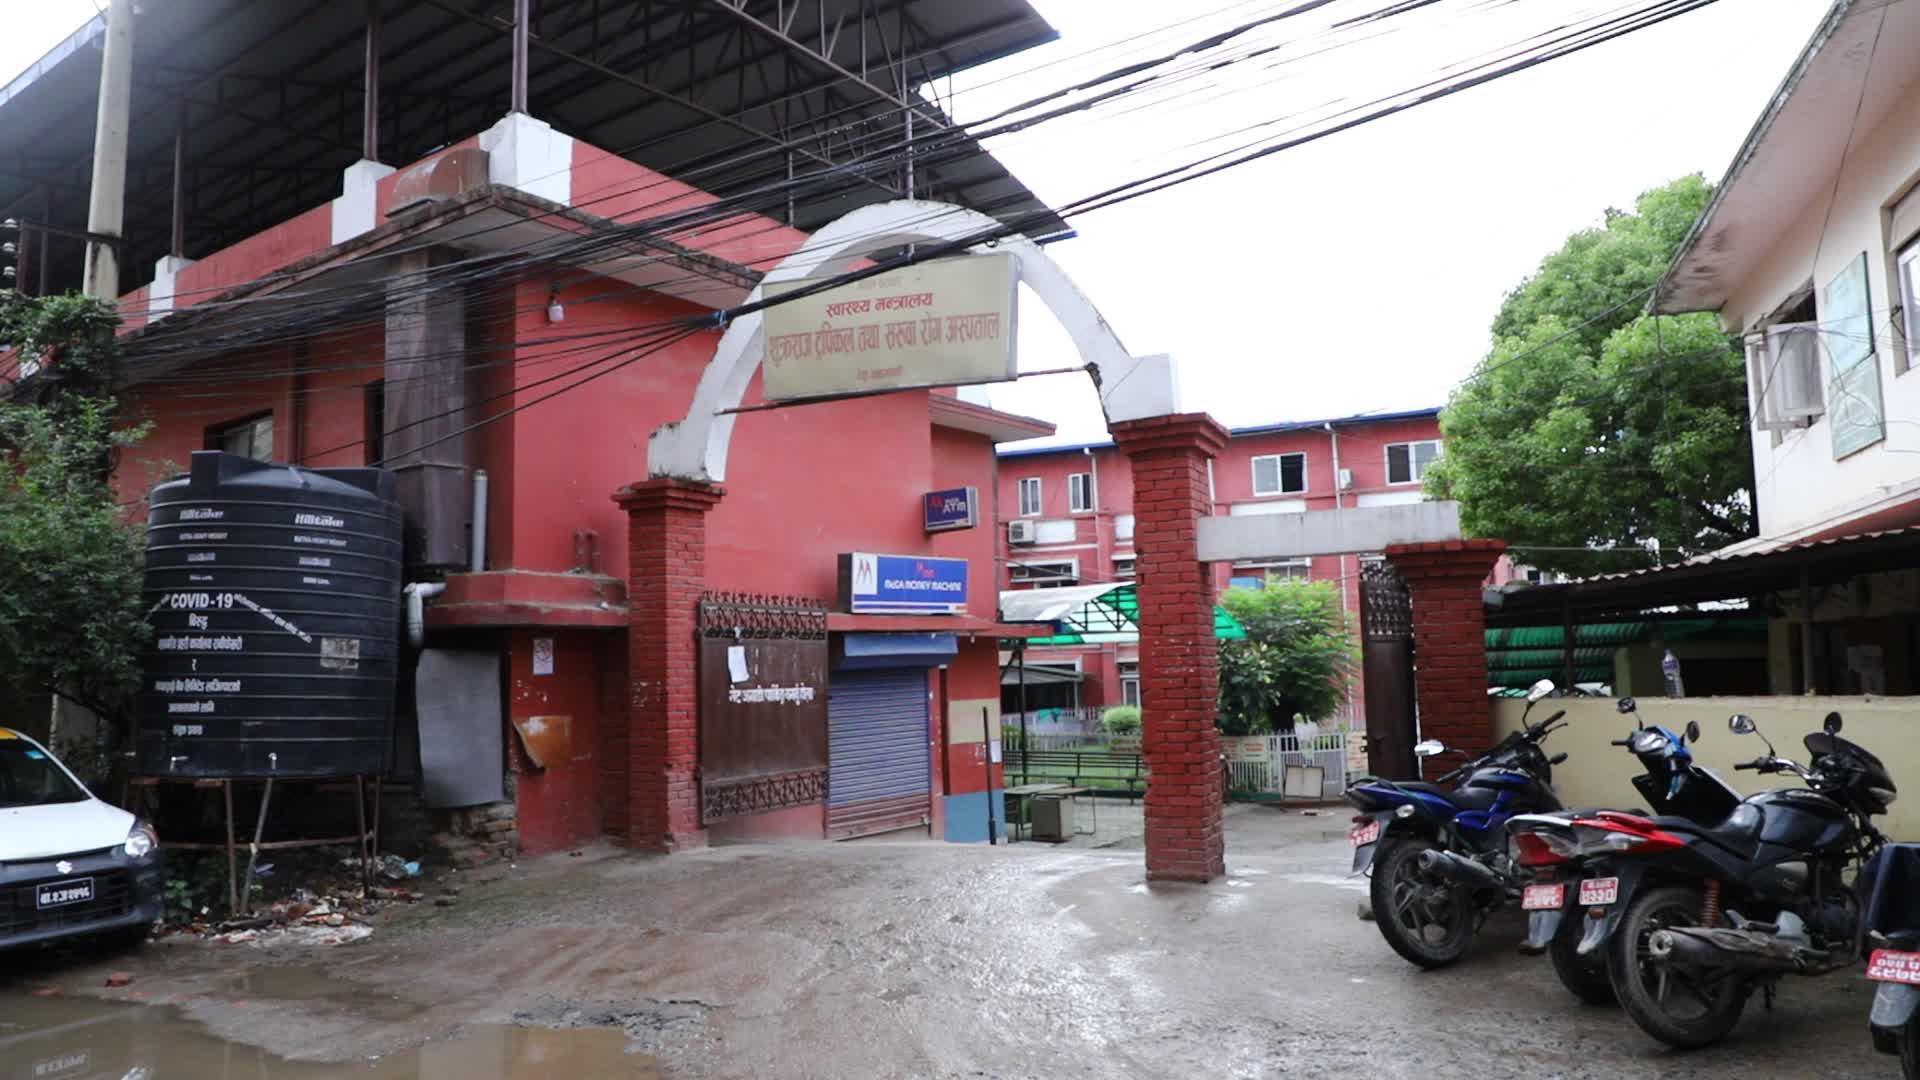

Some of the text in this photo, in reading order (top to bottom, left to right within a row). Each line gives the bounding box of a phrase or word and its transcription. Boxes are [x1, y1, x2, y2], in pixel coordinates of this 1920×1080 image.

[874, 292, 934, 312] मन्त्रालय
[858, 324, 880, 352] तथा
[945, 312, 1000, 343] अस्पताल
